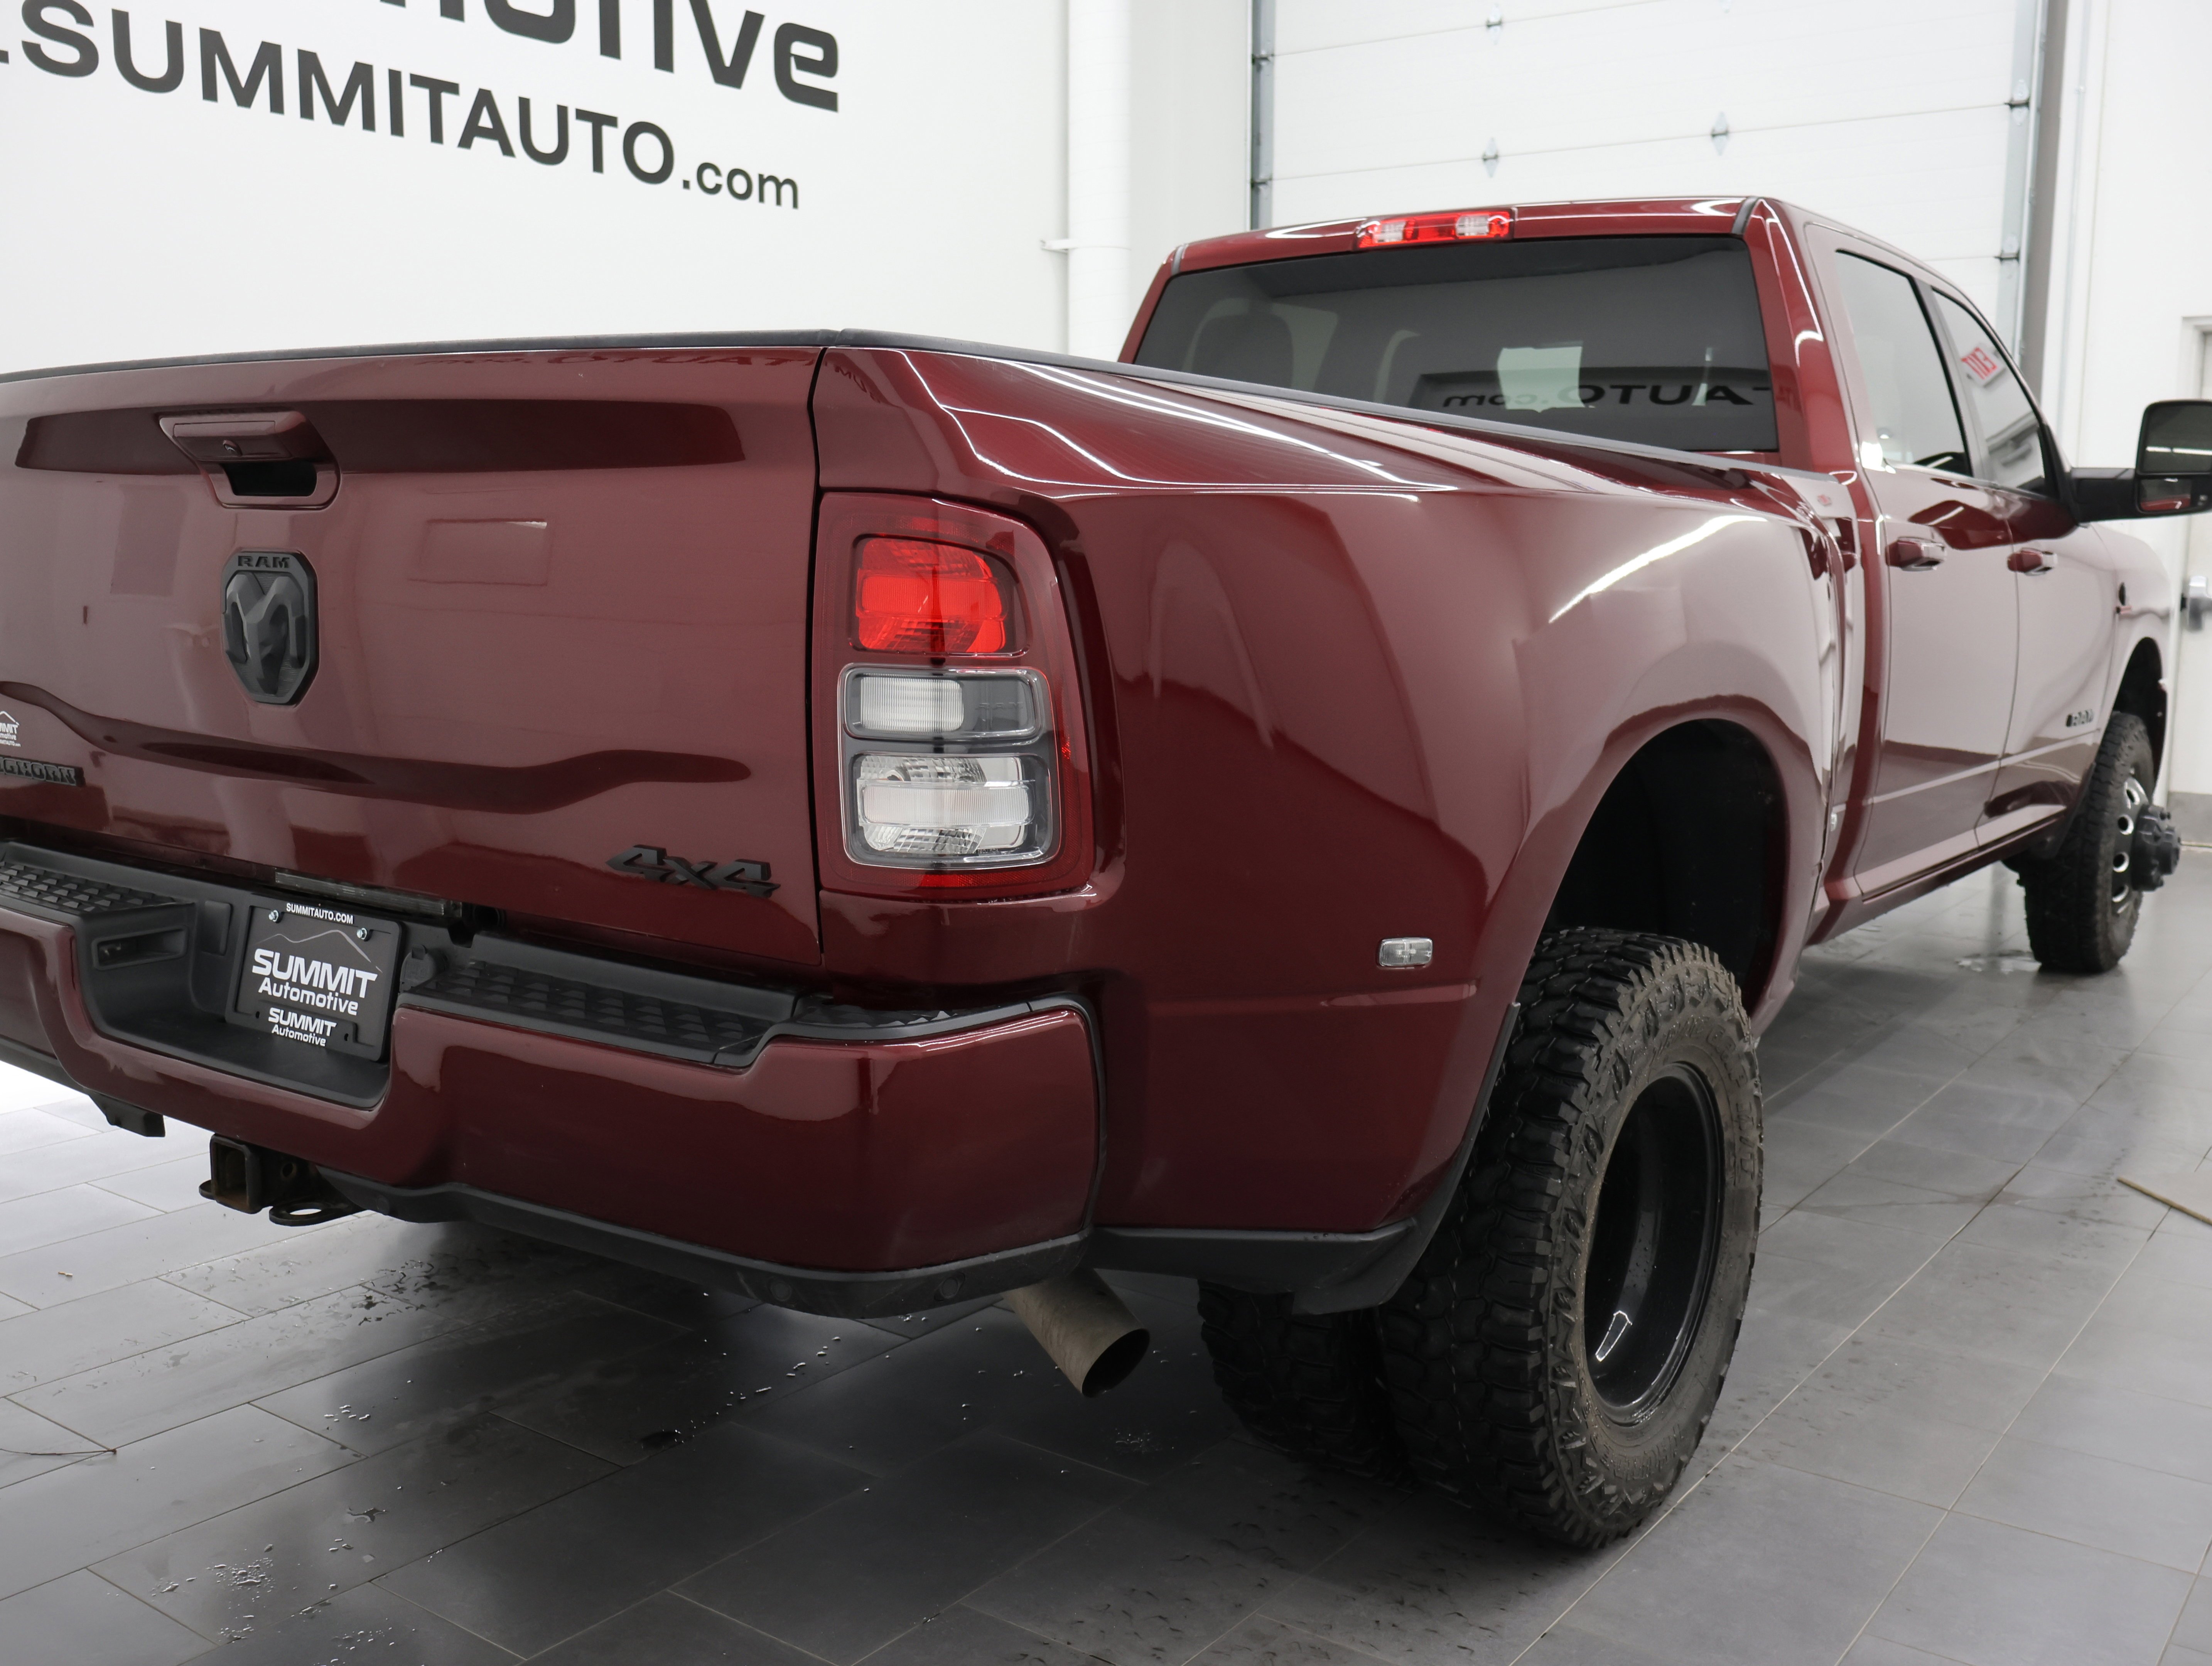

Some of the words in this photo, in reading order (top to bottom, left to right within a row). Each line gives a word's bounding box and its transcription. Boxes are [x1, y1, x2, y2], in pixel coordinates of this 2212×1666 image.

[238, 555, 290, 568] RAM
[0, 756, 77, 786] GHORN
[286, 902, 354, 925] SUMMITAUTO.COM
[251, 948, 378, 998] SUMMIT
[258, 977, 358, 1016] Automotive
[268, 1007, 337, 1037] SUMMIT
[272, 1024, 327, 1047] Automotive
